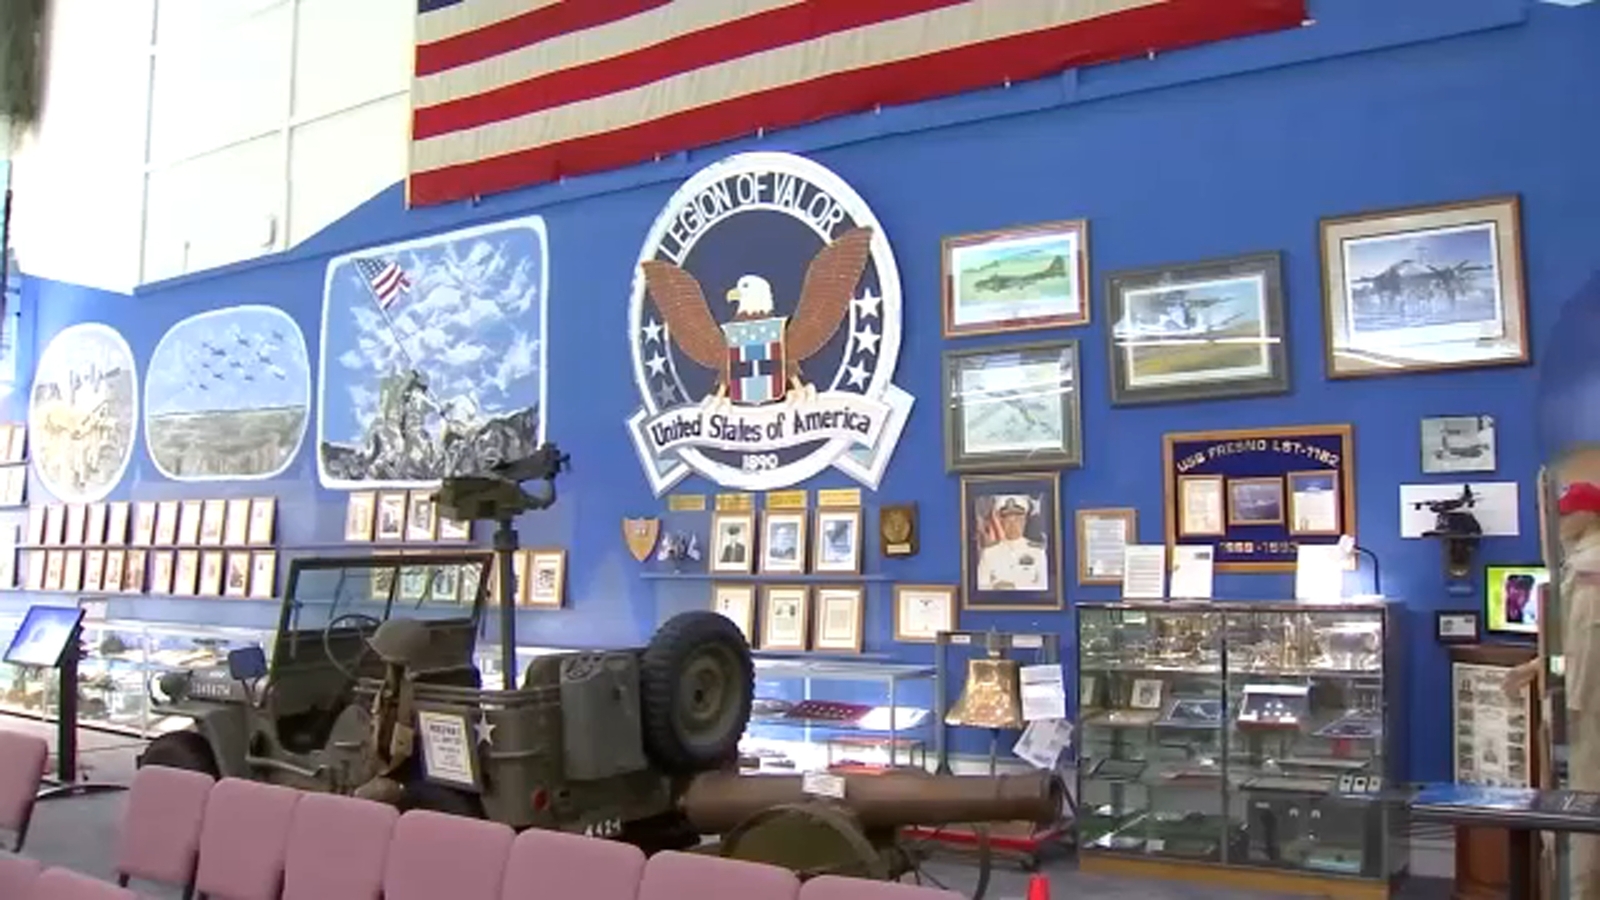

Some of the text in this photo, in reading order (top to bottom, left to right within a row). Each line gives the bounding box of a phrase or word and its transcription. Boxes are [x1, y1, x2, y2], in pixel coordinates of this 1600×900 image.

[658, 171, 846, 266] LEGION OF VALOR
[651, 407, 872, 447] United States of America
[742, 452, 780, 471] 1890
[1208, 439, 1267, 460] FRESNO
[1272, 440, 1341, 468] LST-1182
